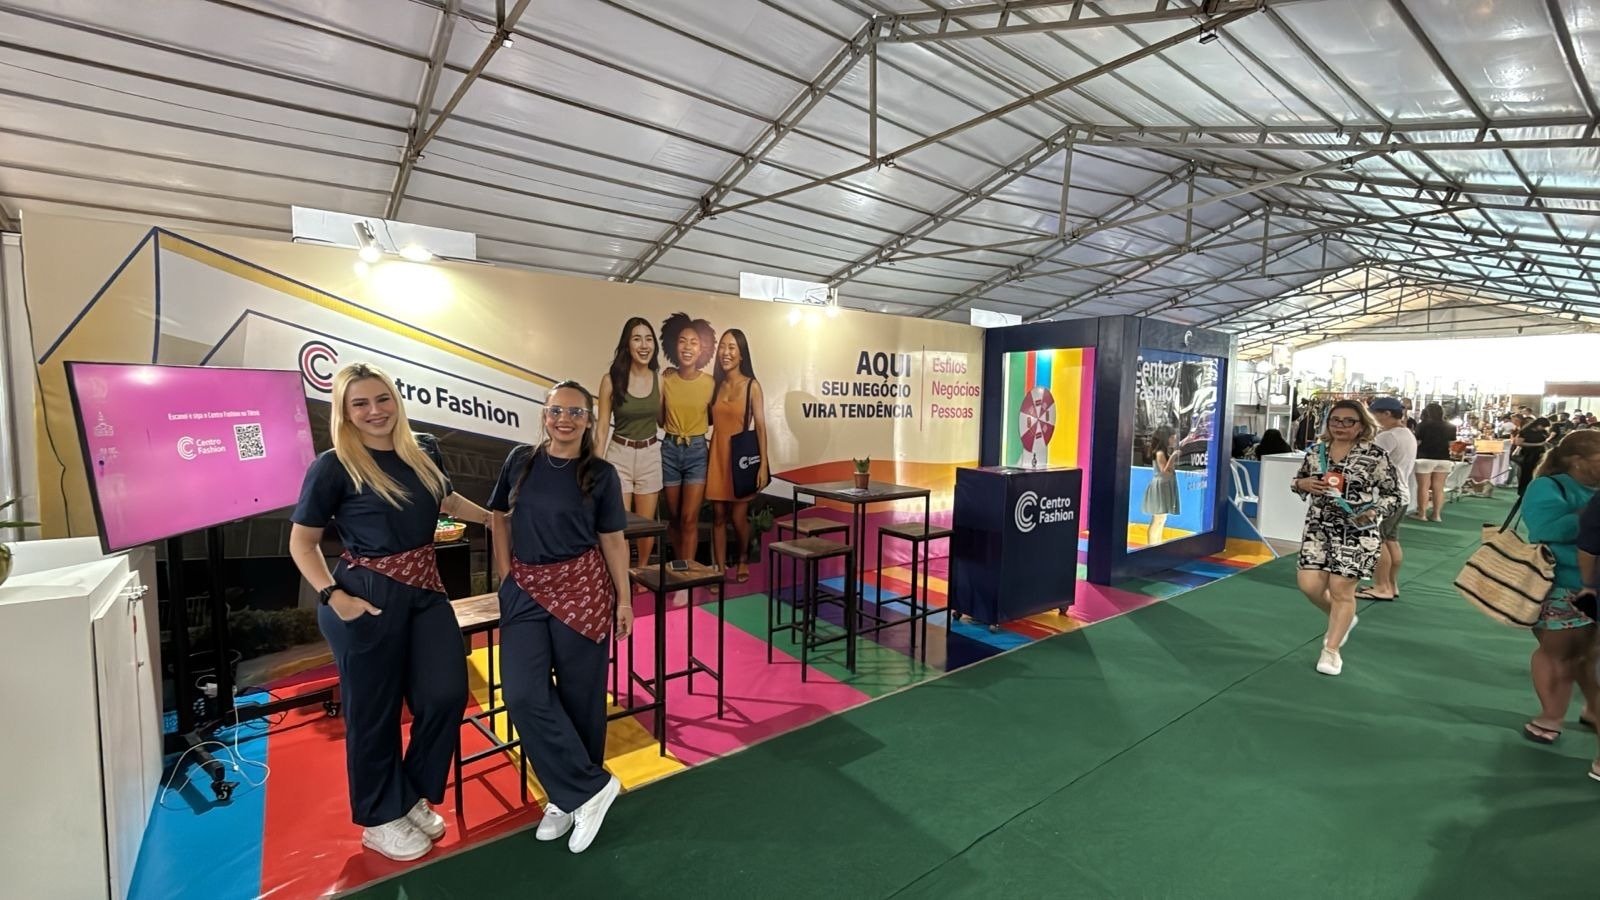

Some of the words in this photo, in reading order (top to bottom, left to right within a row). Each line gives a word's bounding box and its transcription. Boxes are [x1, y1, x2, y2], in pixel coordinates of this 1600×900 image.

[856, 350, 911, 379] AQUI
[821, 380, 849, 397] SEU
[852, 379, 911, 398] NEGÓCIO
[931, 380, 980, 400] Negócios
[394, 377, 431, 405] tro
[435, 386, 519, 428] Fashion
[803, 403, 837, 418] VIRA
[839, 401, 913, 418] TENDÊNCIA
[931, 403, 973, 418] Pessoas
[196, 439, 221, 447] Centro
[198, 446, 226, 454] Fashion
[1040, 496, 1071, 509] Centro
[1039, 509, 1074, 523] Fashion
